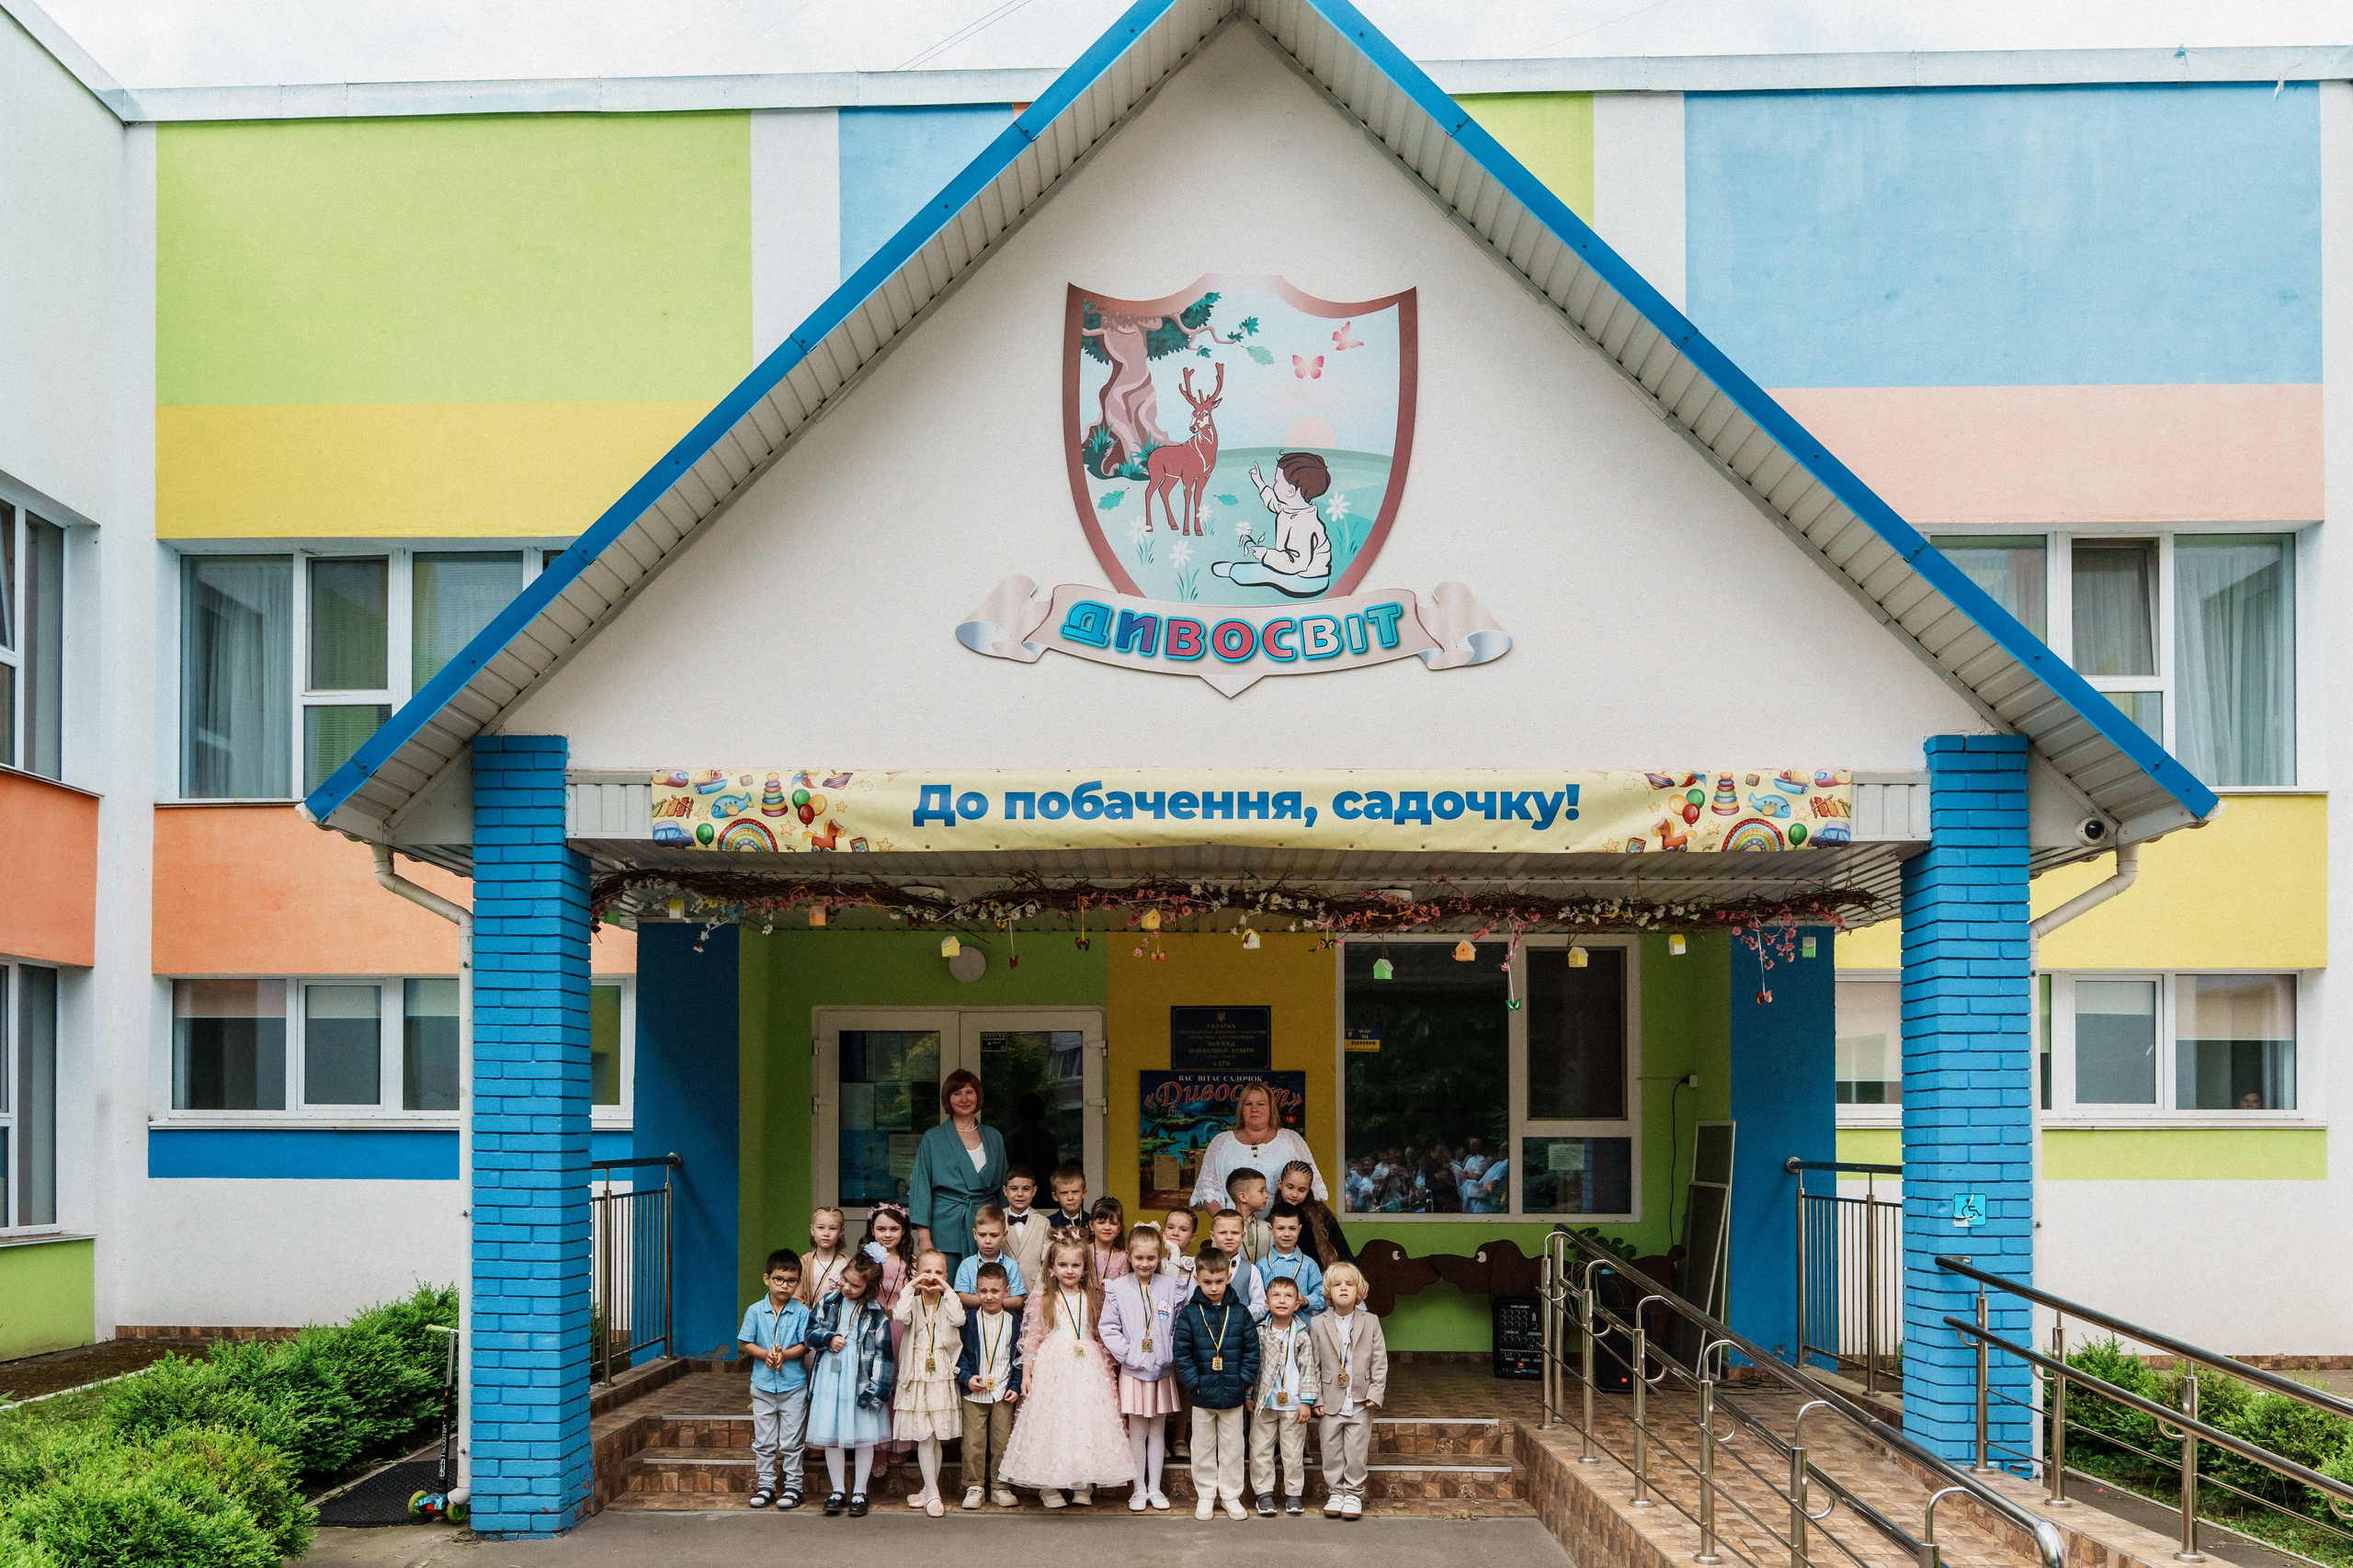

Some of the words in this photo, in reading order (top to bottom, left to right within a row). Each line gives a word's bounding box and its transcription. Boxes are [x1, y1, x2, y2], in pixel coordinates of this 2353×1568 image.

[1060, 600, 1402, 663] ДИВОСВІТ
[913, 784, 989, 826] До
[1005, 780, 1317, 828] побачення,
[1333, 784, 1580, 831] садочку!
[1143, 1081, 1302, 1109] «Дивост»
